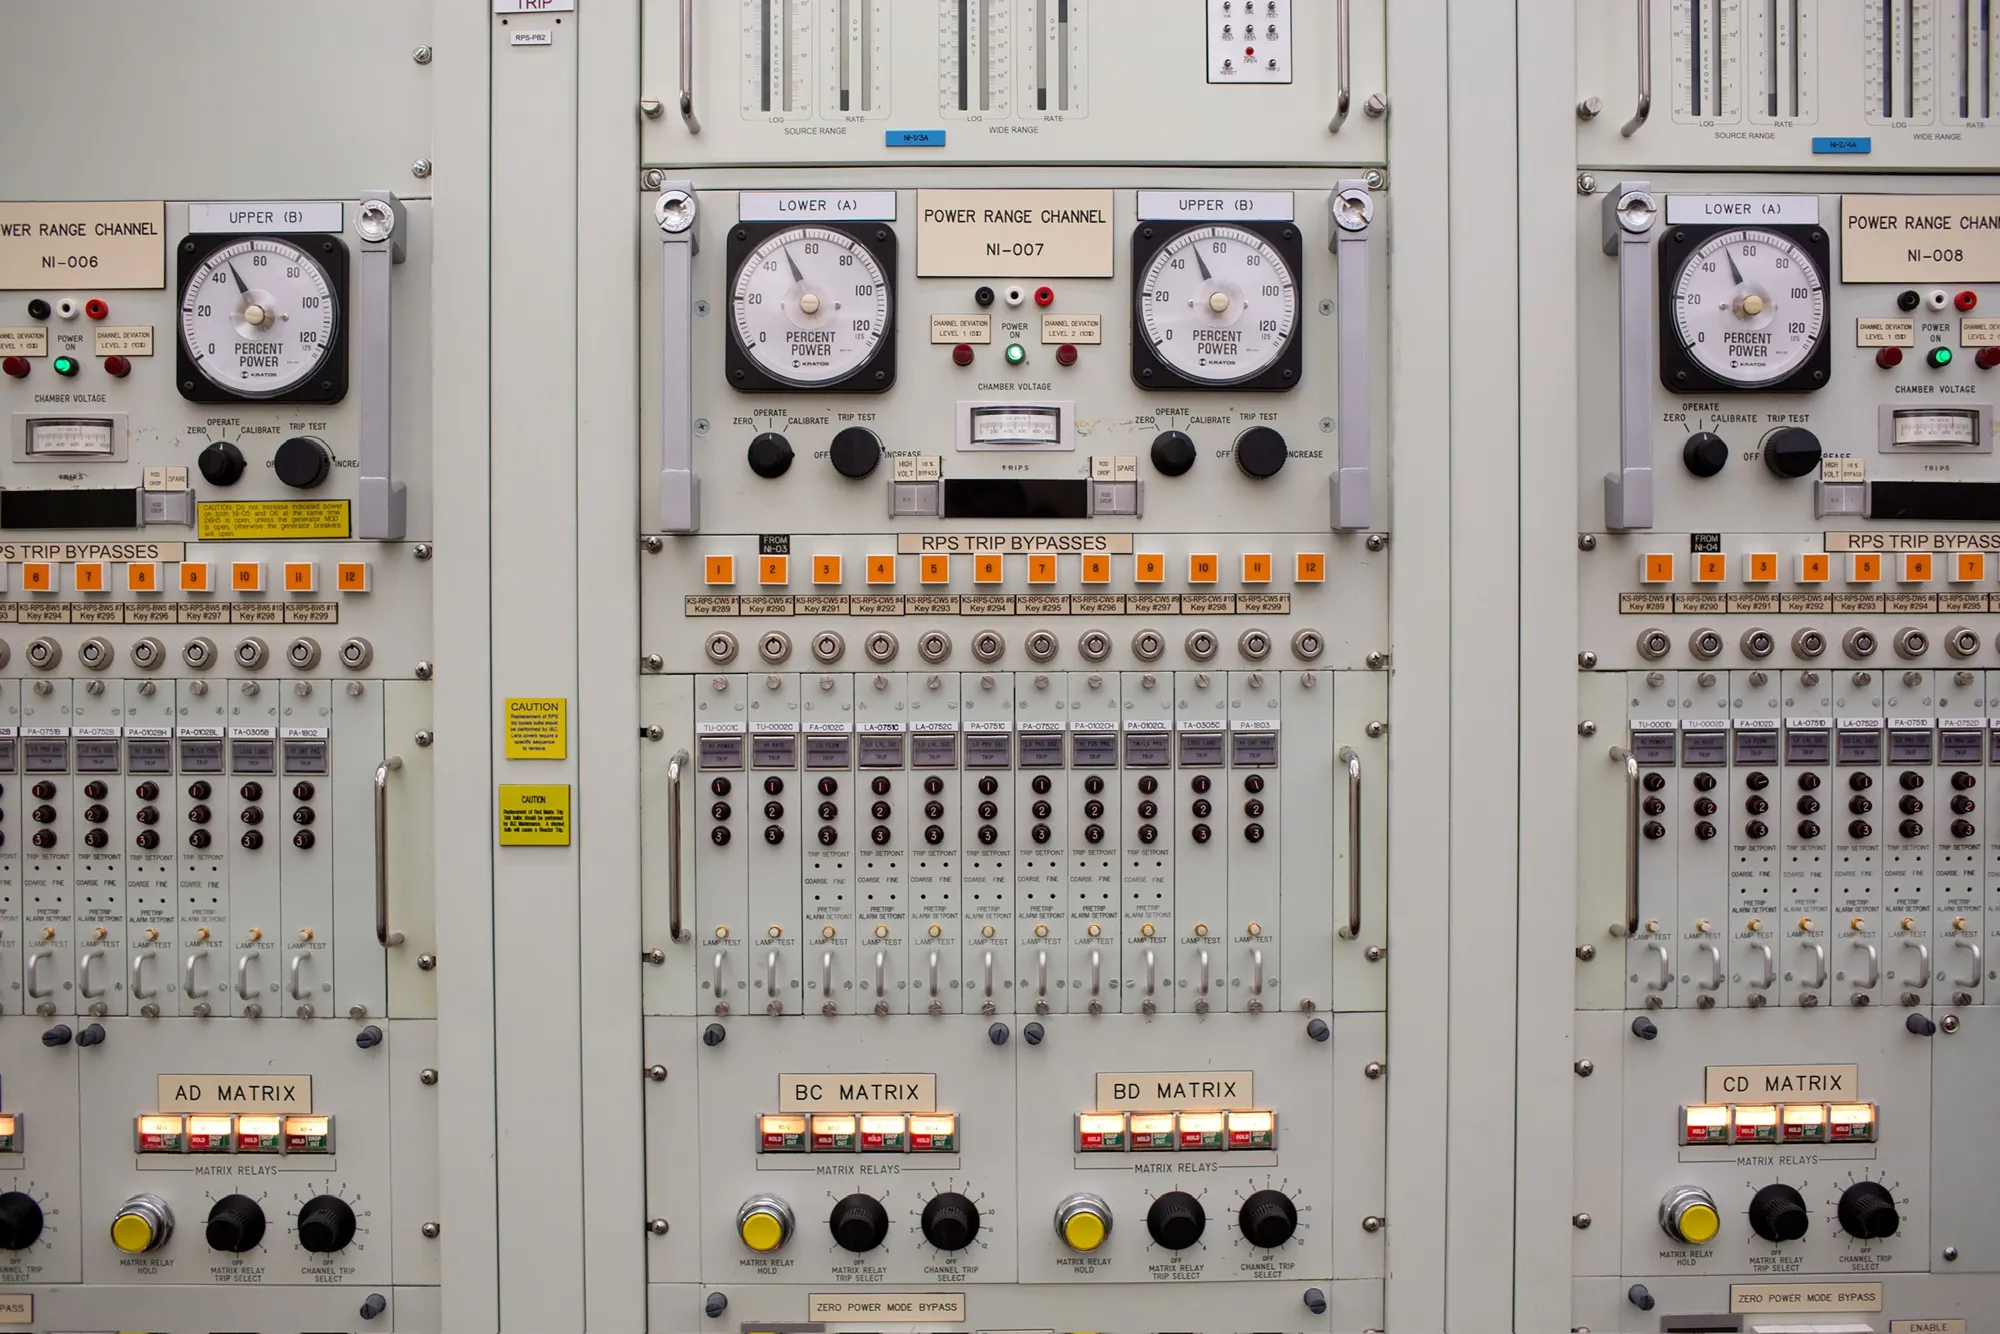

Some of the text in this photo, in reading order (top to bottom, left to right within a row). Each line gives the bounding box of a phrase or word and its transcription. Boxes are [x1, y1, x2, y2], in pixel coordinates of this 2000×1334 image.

[516, 34, 545, 42] RPS-PB2
[769, 116, 784, 124] LOG
[846, 115, 866, 123] RATE
[785, 126, 846, 135] SOURCE RANGE
[989, 125, 1038, 133] WIDE RANGE
[1715, 131, 1775, 139] SOURCE RANGE
[1913, 133, 1961, 141] WIDE RANGE
[780, 200, 856, 211] LOWER (A)
[1706, 204, 1780, 214] LOWER (A)
[230, 212, 302, 223] UPPER (B)
[925, 210, 1106, 223] POWER RANGE CHANNEL
[1849, 216, 1951, 229] POWER RANGE
[1, 223, 157, 236] WER RANGE CHANNEL
[805, 243, 818, 254] 60
[987, 243, 1044, 256] NI-007
[1908, 249, 1963, 261] NI-008
[43, 256, 98, 268] NI-006
[840, 255, 852, 266] 80
[763, 261, 777, 271] 40
[856, 285, 872, 296] 100
[749, 294, 761, 304] 20
[853, 320, 869, 331] 120
[1002, 322, 1028, 330] POWER
[759, 332, 767, 342] 0
[787, 332, 835, 342] PERCENT
[1009, 331, 1021, 339] ON
[1724, 332, 1772, 344] PERCENT
[235, 343, 283, 354] PERCENT
[792, 344, 830, 355] POWER
[1729, 345, 1767, 357] POWER
[240, 356, 278, 367] POWER
[978, 382, 1051, 390] CHAMBER VOLTAGE
[35, 393, 106, 402] CHAMBER VOLTAGE
[754, 408, 787, 416] OPERATE
[838, 412, 876, 421] TRIP TEST
[733, 416, 753, 424] ZERO
[788, 416, 828, 424] CALIBRATE
[1216, 450, 1230, 458] OFF
[1744, 452, 1760, 461] OFF
[1117, 463, 1136, 473] SPARE
[1924, 464, 1949, 472] TRIPS
[764, 535, 787, 544] FROM
[1695, 534, 1718, 542] FROM
[923, 536, 1106, 550] RPS TRIP BYPASSES
[21, 545, 158, 558] TRIP BYPASSES
[764, 544, 787, 553] NI-03
[769, 564, 776, 573] 2
[877, 564, 884, 573] 4
[985, 563, 993, 572] 6
[1038, 564, 1046, 573] 7
[1863, 562, 1871, 571] 5
[346, 572, 355, 581] 12
[695, 605, 730, 614] Key #289
[1136, 603, 1171, 612] Key #297
[1841, 602, 1876, 611] Key #293
[27, 611, 61, 622] Key #294
[511, 702, 558, 711] CAUTION
[810, 723, 844, 731] FA-0102C
[916, 722, 952, 730] LA-0752C
[1184, 721, 1220, 729] TA-0305C
[1241, 721, 1270, 729] PA-1803
[1689, 720, 1724, 728] TU-0002D
[1945, 719, 1980, 727] PA-0752D
[28, 728, 60, 736] PA-0751B
[79, 728, 114, 736] PA-0752B
[704, 724, 738, 732] TU-0001C
[289, 729, 317, 737] PA-1802
[522, 795, 545, 803] CAUTION
[1072, 849, 1116, 857] TRIP SETPOINT
[1885, 869, 1924, 878] COARSE FINE
[1083, 905, 1106, 913] PRETRIP
[1094, 911, 1118, 919] SETPOINT
[1182, 936, 1220, 945] LAMP TEST
[1724, 1075, 1841, 1092] CD MATRIX
[175, 1085, 295, 1101] AD MATRIX
[796, 1085, 918, 1100] BC MATRIX
[1737, 1155, 1817, 1166] MATRIX RELAYS
[817, 1165, 900, 1175] MATRIX RELAYS
[1057, 1256, 1111, 1265] MATRIX RELAY
[302, 1266, 355, 1275] CHANNEL TRIP
[1075, 1265, 1094, 1273] HOLD
[315, 1274, 342, 1282] SELECT
[1739, 1292, 1876, 1303] ZERO POWER MODE BYPASS
[817, 1302, 957, 1311] ZERO POWER MODE BYPASS
[1910, 1323, 1947, 1332] ENABLE
